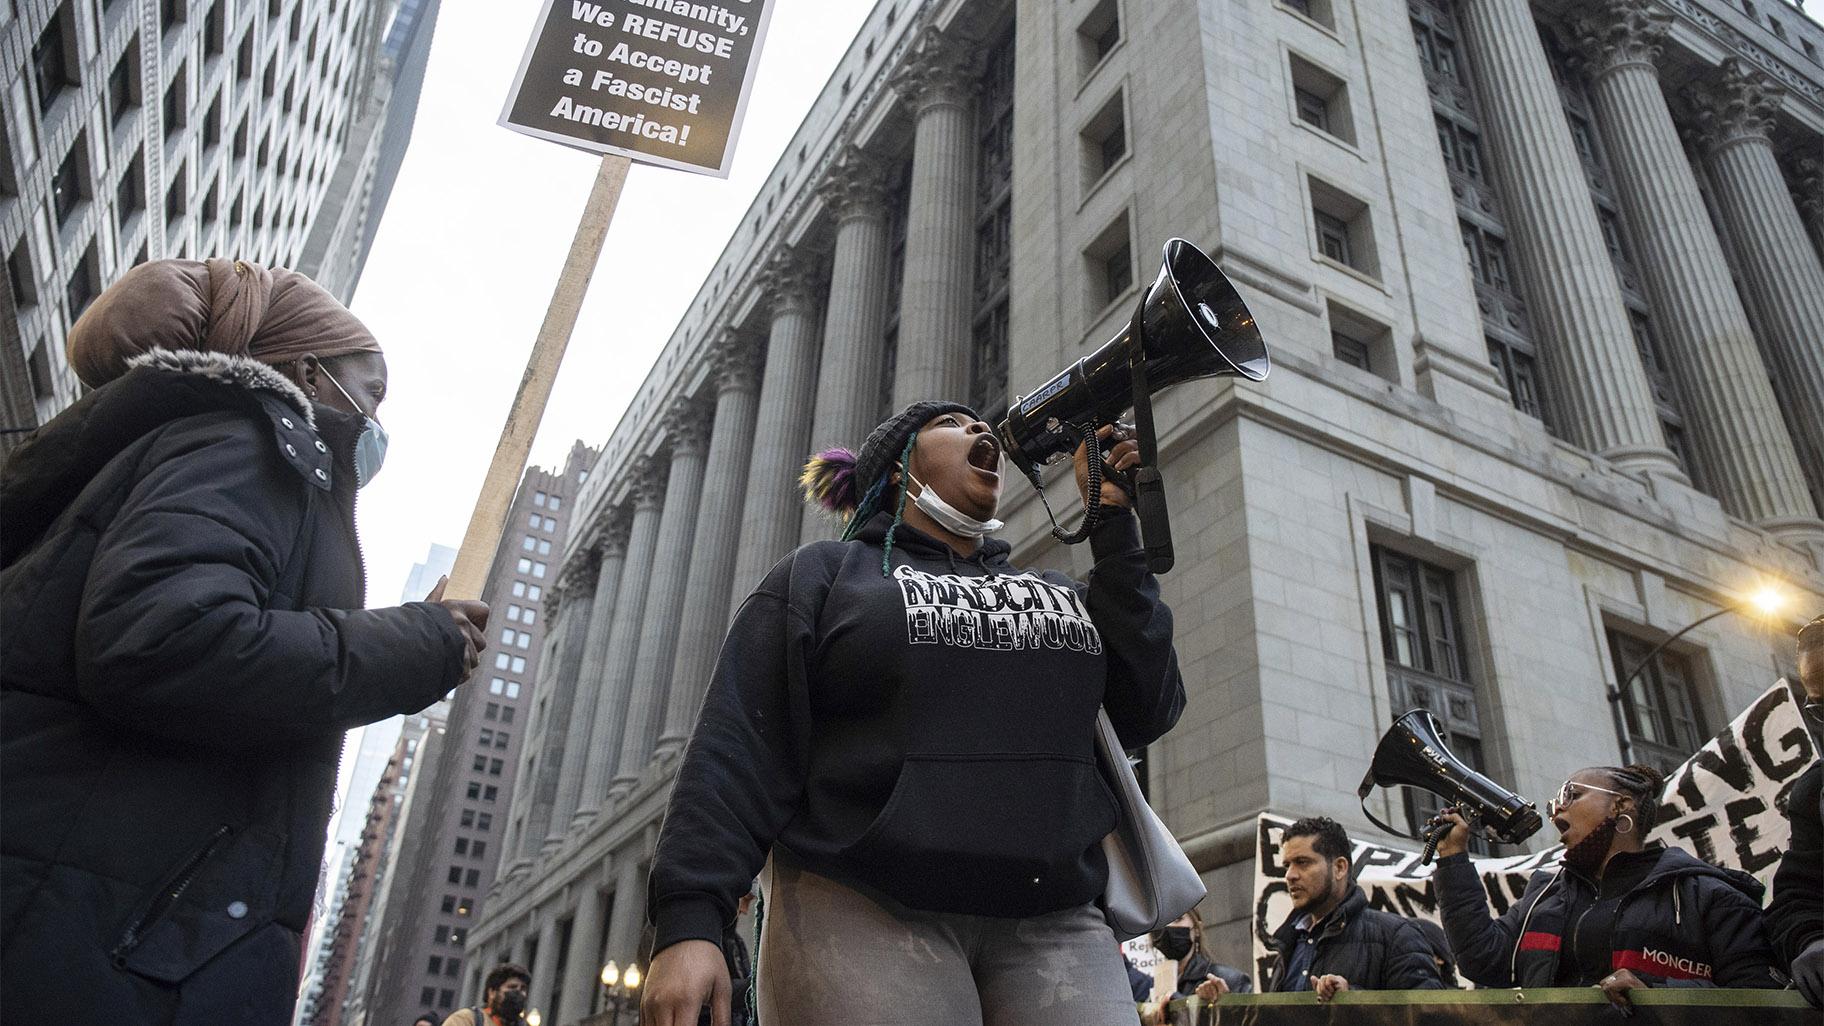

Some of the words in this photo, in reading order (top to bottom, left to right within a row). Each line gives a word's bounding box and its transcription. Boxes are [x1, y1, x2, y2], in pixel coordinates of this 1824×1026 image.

[571, 0, 615, 27] We
[622, 13, 734, 58] REFUSE
[573, 33, 602, 56] to
[608, 42, 712, 84] Accept
[562, 68, 583, 86] a
[591, 70, 701, 114] Fascist
[550, 96, 691, 146] America!
[906, 607, 1102, 655] ENGLEWOOD
[1643, 946, 1712, 978] MONCLER
